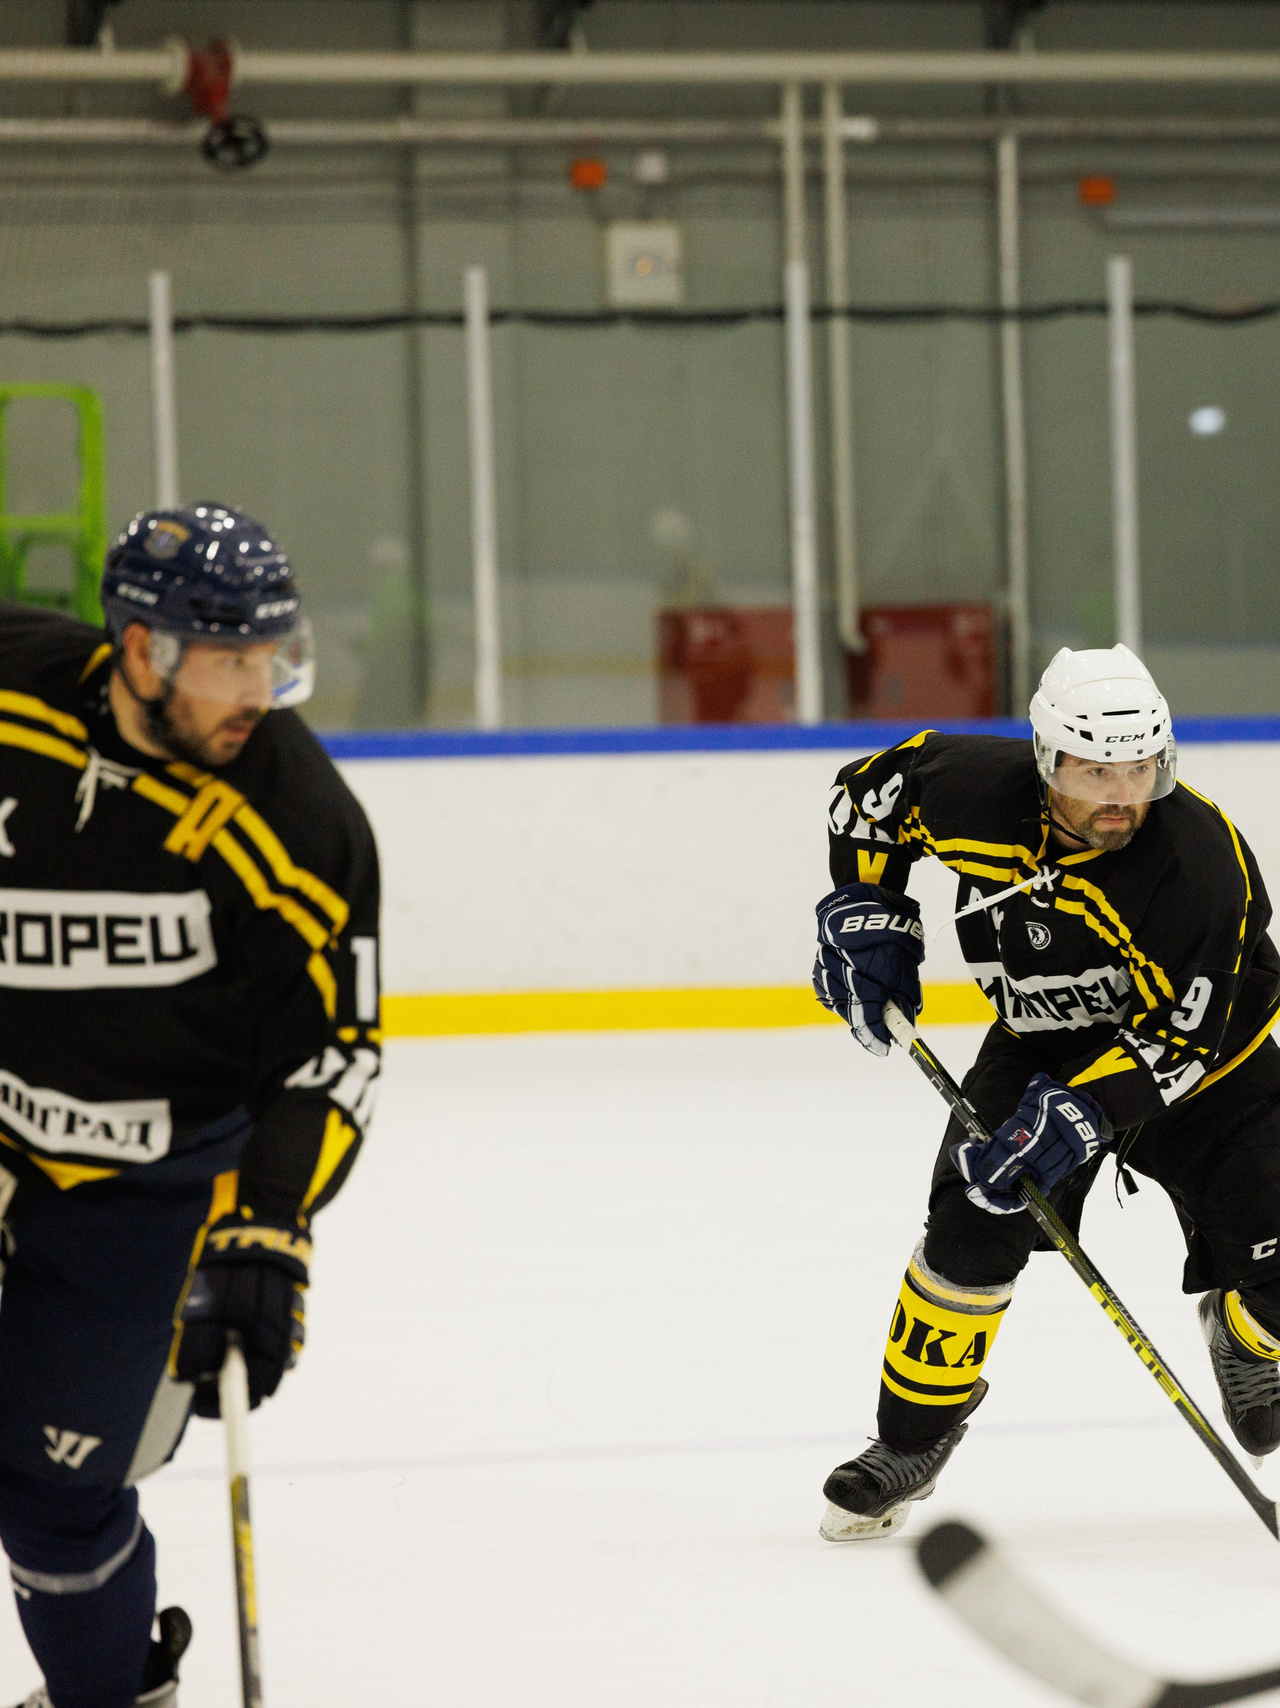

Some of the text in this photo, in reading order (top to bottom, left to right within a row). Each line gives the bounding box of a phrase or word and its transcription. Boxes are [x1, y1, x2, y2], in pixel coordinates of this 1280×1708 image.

[1104, 732, 1146, 744] CCM
[861, 772, 904, 822] 9
[0, 911, 199, 967] ОРЕЦ
[839, 913, 925, 941] BAUE
[1170, 976, 1213, 1032] 9
[1054, 1235, 1076, 1262] 3X
[1096, 1286, 1176, 1398] TRUE
